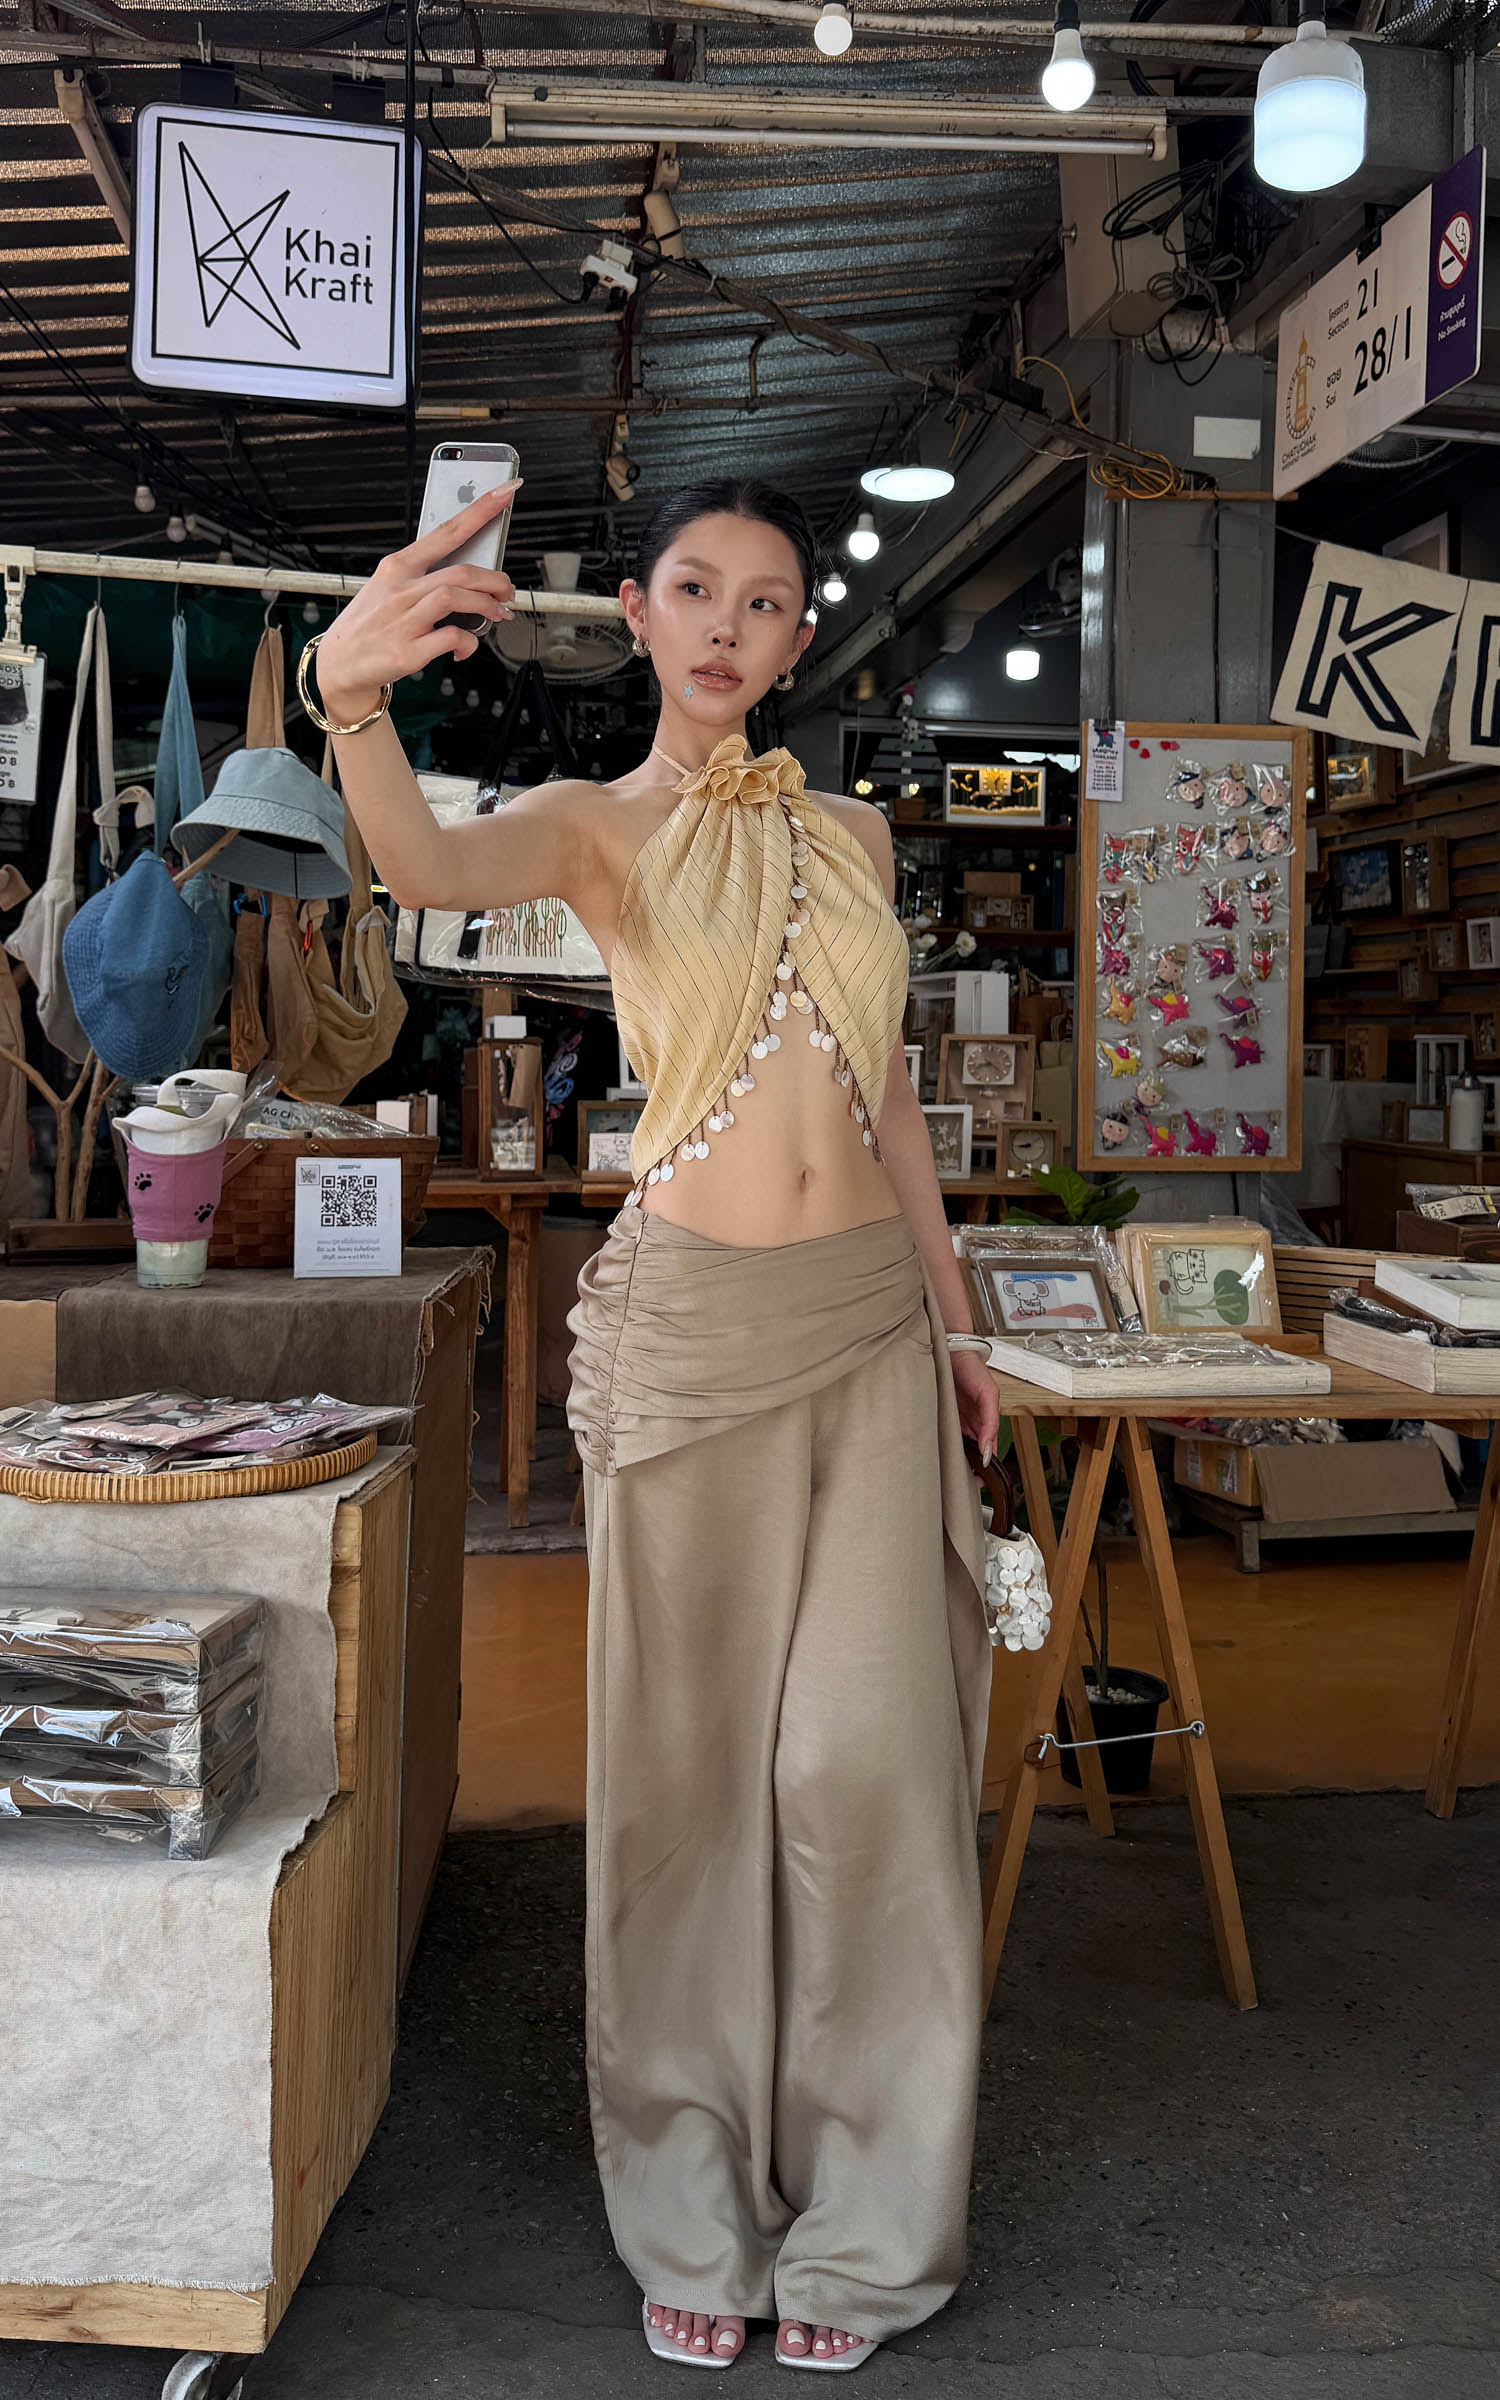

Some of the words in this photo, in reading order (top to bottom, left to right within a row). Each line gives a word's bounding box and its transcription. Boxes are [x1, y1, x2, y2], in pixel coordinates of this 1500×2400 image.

[285, 226, 372, 268] Khai
[285, 266, 373, 304] Kraft
[1357, 268, 1379, 320] 21
[1327, 317, 1350, 340] Section
[1353, 305, 1412, 396] 28/1
[1325, 389, 1336, 409] Soi
